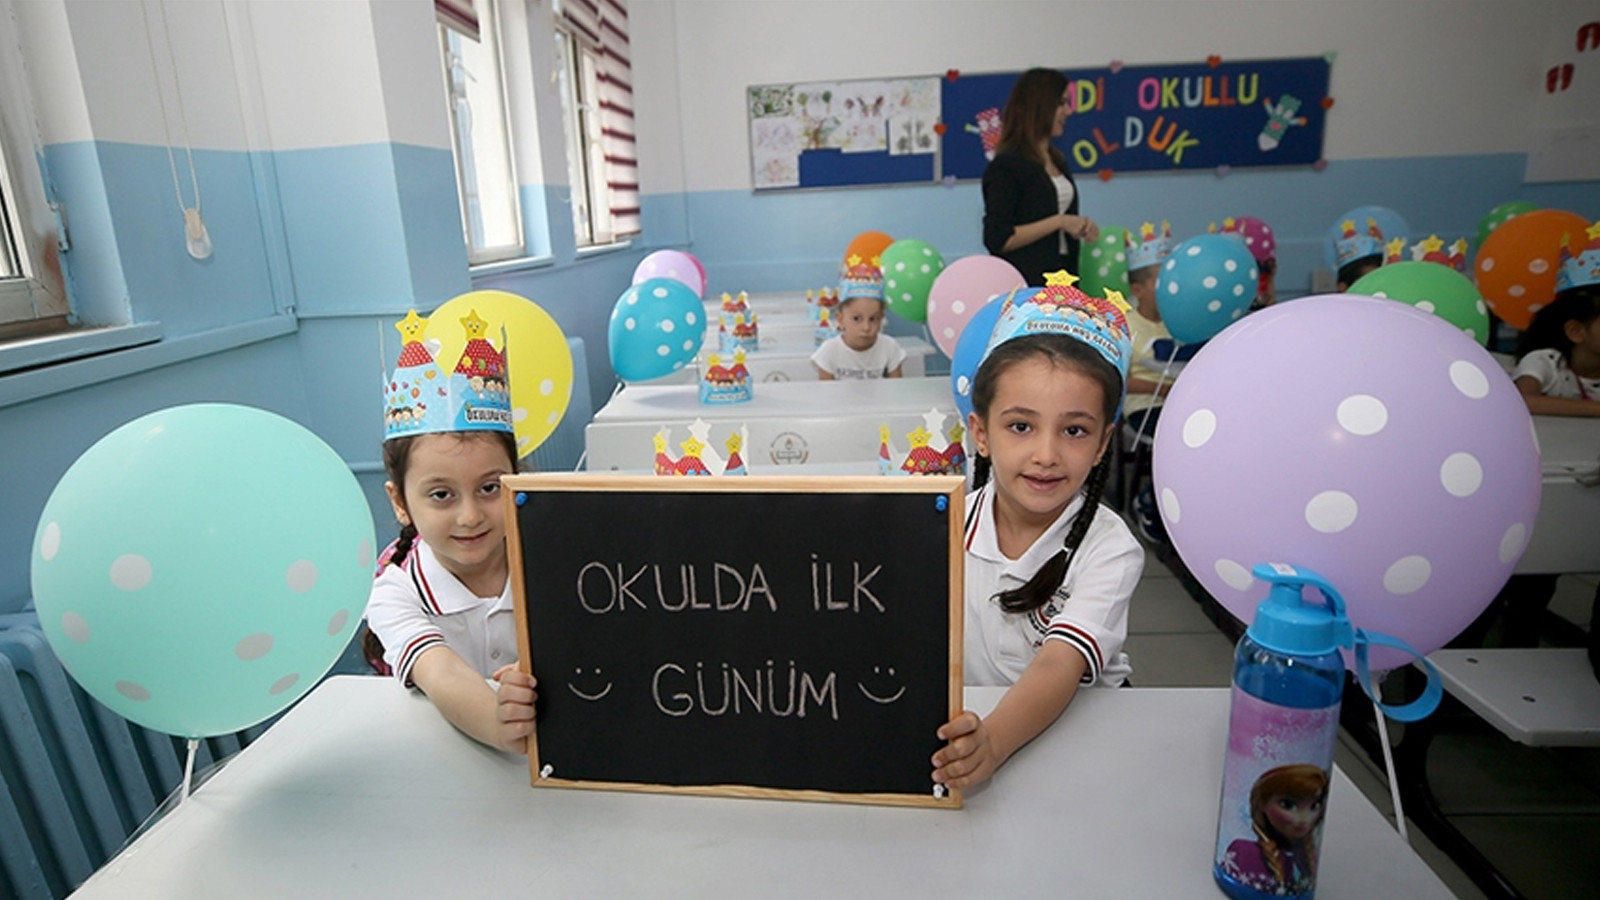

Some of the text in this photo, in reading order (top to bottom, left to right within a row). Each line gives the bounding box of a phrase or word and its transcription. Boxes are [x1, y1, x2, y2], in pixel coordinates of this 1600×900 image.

[1137, 73, 1259, 111] OKULLU
[1072, 115, 1200, 169] OLDUK
[577, 553, 886, 614] OKULDA İLK
[652, 659, 839, 720] GÜNÜM
